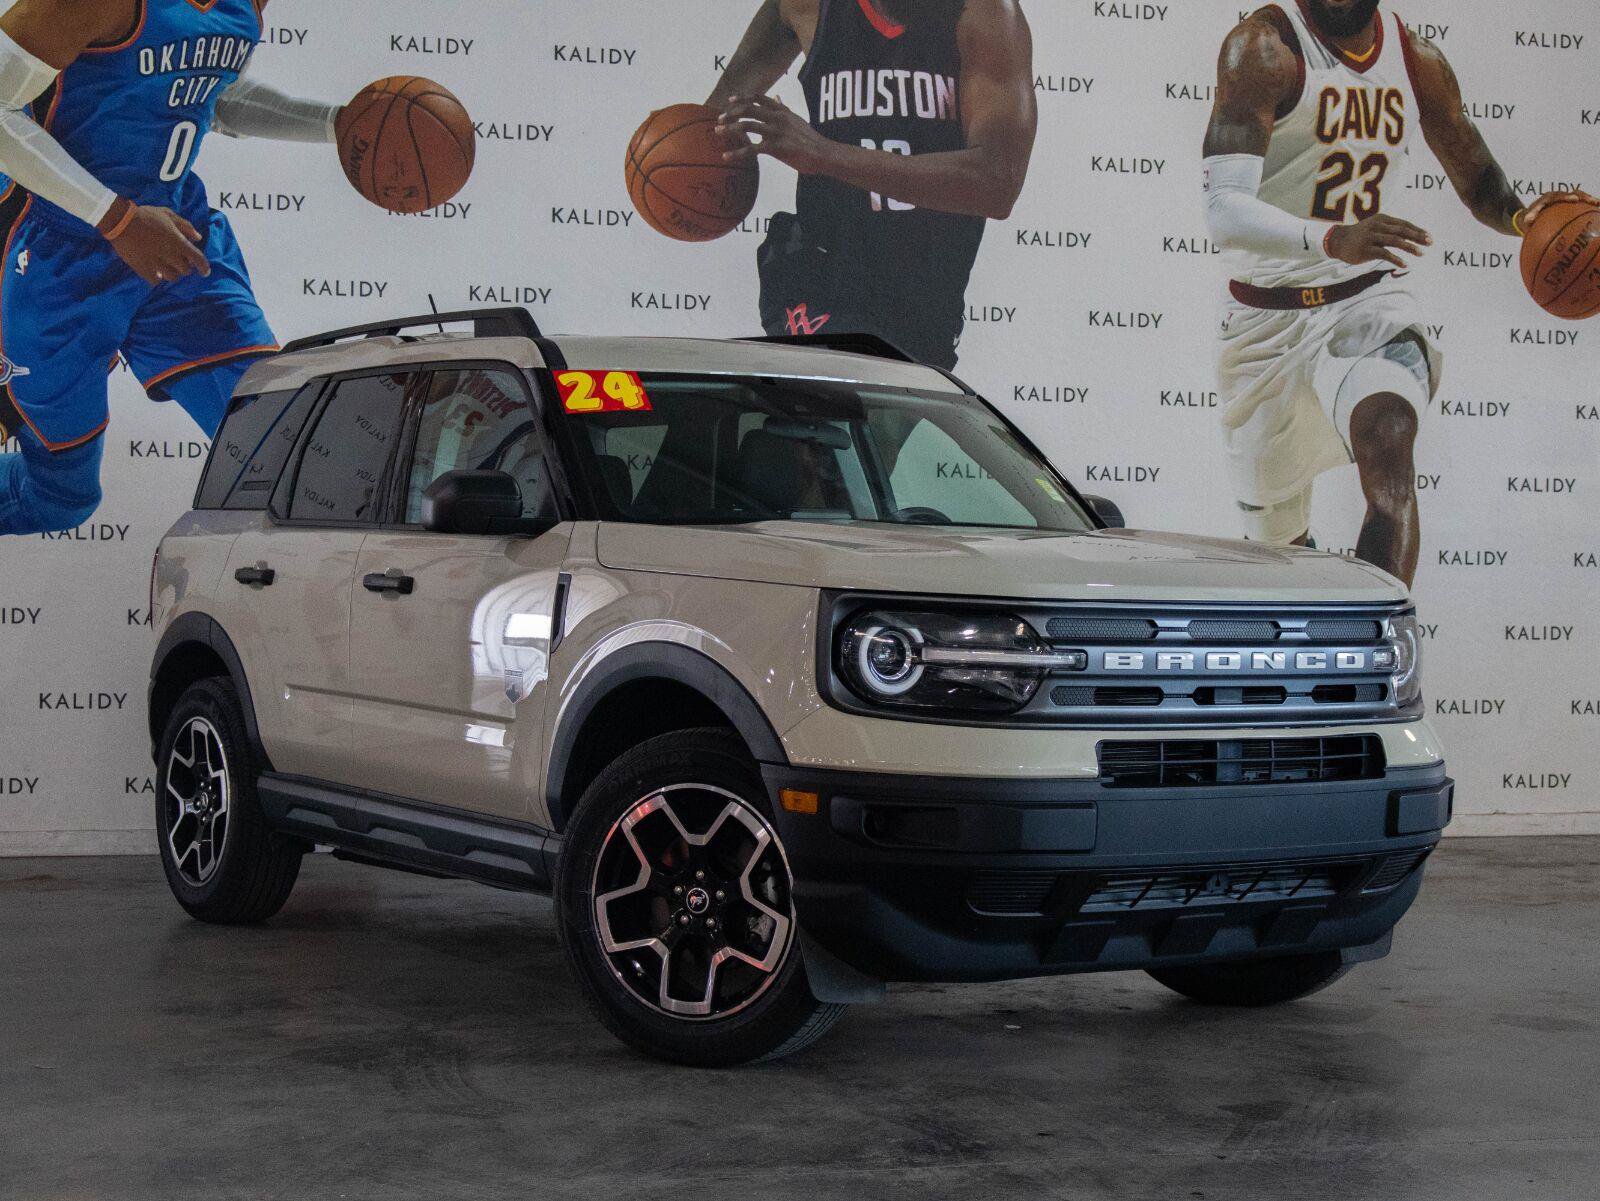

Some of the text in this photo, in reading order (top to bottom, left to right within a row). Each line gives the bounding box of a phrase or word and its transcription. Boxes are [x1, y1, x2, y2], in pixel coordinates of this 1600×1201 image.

[1095, 2, 1168, 21] KALIDY
[391, 35, 473, 55] KALIDY
[1516, 31, 1583, 49] KALIDY
[554, 45, 636, 65] KALIDY
[168, 76, 219, 108] CITY
[819, 69, 957, 123] HOUSTON
[1315, 86, 1405, 146] CAVS
[472, 122, 554, 141] KALIDY
[1092, 156, 1165, 174] KALIDY
[1309, 151, 1389, 224] 23
[220, 192, 305, 211] KALIDY
[552, 207, 633, 226] KALIDY
[1017, 230, 1091, 248] KALIDY
[1444, 251, 1512, 268] KALIDY
[304, 279, 387, 297] KALIDY
[470, 285, 552, 304] KALIDY
[1301, 287, 1326, 306] CLE
[632, 292, 710, 310] KALIDY
[1089, 311, 1163, 328] KALIDY
[1511, 329, 1579, 345] KALIDY
[557, 371, 643, 411] 24
[1014, 386, 1088, 403] KALIDY
[1441, 400, 1510, 416] KALIDY
[1087, 466, 1160, 482] KALIDY
[1508, 477, 1576, 492] KALIDY
[1439, 550, 1507, 566] KALIDY
[1505, 626, 1573, 641] KALIDY
[1103, 651, 1365, 670] BRONCO
[39, 692, 127, 709] KALIDY
[1436, 699, 1505, 715] KALIDY
[1503, 774, 1571, 789] KALIDY
